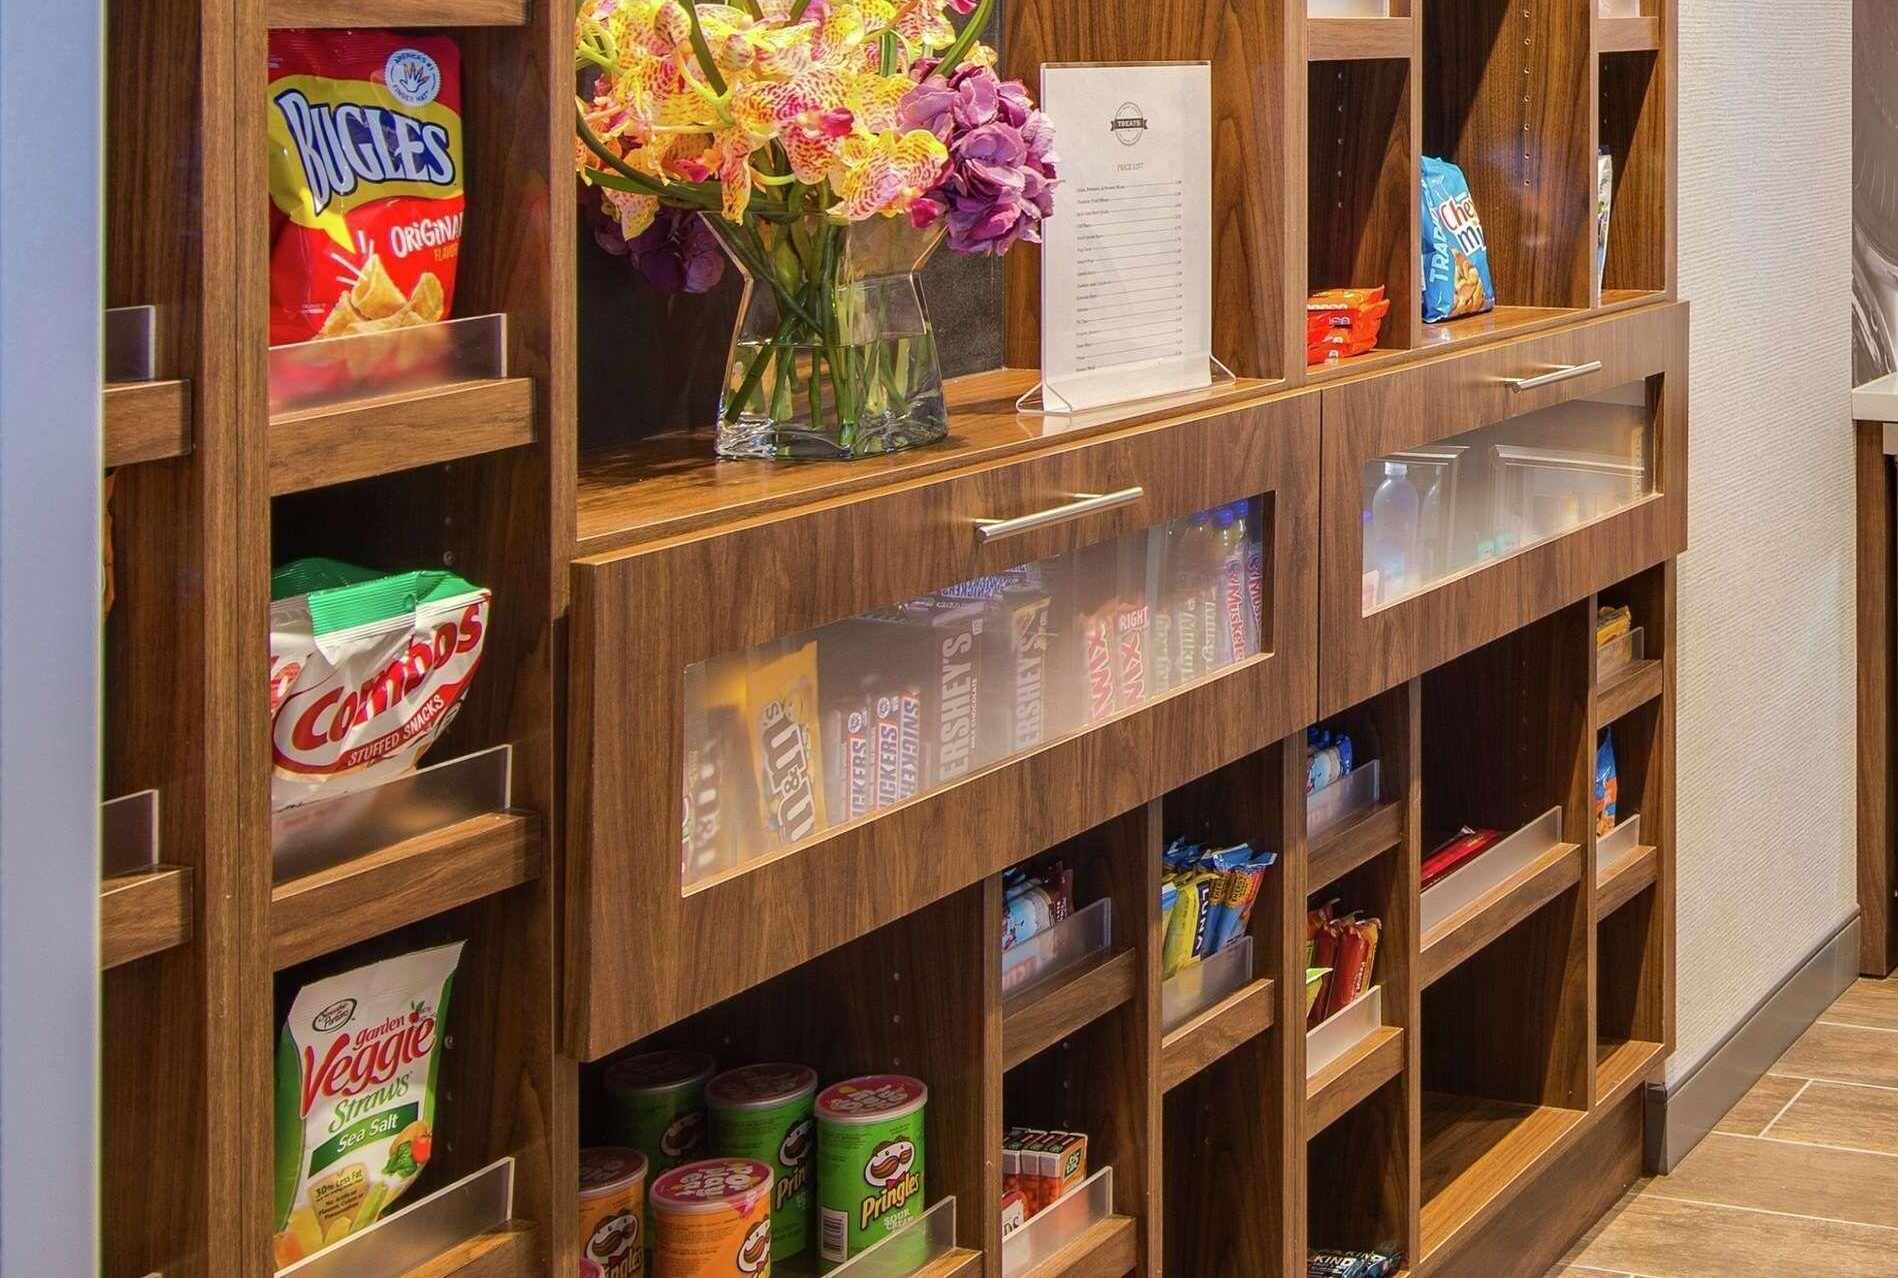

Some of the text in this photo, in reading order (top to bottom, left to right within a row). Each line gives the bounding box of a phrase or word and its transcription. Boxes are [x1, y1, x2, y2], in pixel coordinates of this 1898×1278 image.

[274, 88, 456, 216] BUGLES
[1119, 605, 1148, 632] RIGHT
[347, 694, 445, 767] STUFFED SNACKS
[352, 1015, 405, 1051] garden
[301, 1017, 437, 1119] Veggie
[328, 1073, 411, 1134] Straws
[336, 1113, 399, 1153] Sea Salt
[859, 1172, 920, 1231] Pringles
